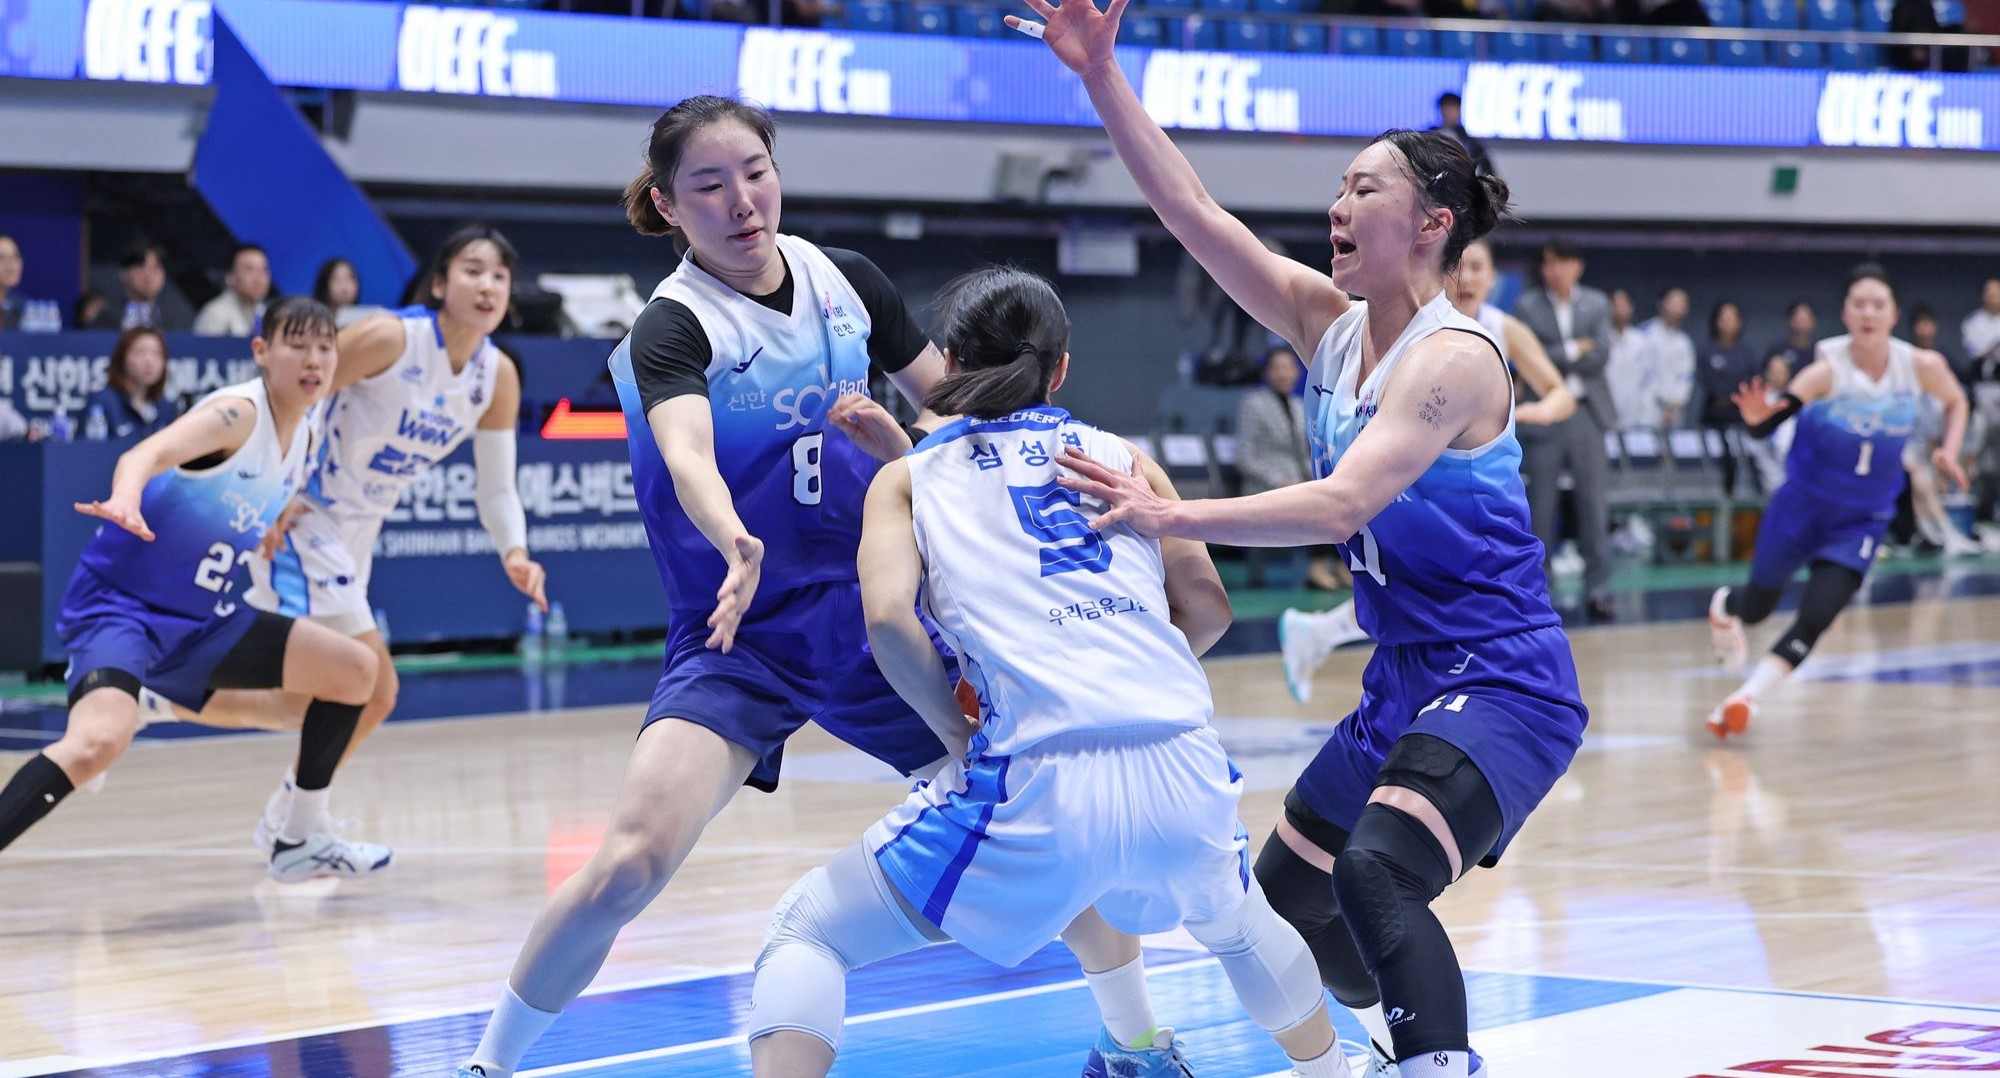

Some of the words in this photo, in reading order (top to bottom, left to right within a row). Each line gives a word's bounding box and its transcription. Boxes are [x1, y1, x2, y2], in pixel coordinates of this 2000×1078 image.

[833, 322, 856, 337] 인천
[728, 390, 767, 411] 신한
[791, 431, 824, 506] 8
[1855, 440, 1874, 476] 1
[1007, 477, 1113, 578] 5
